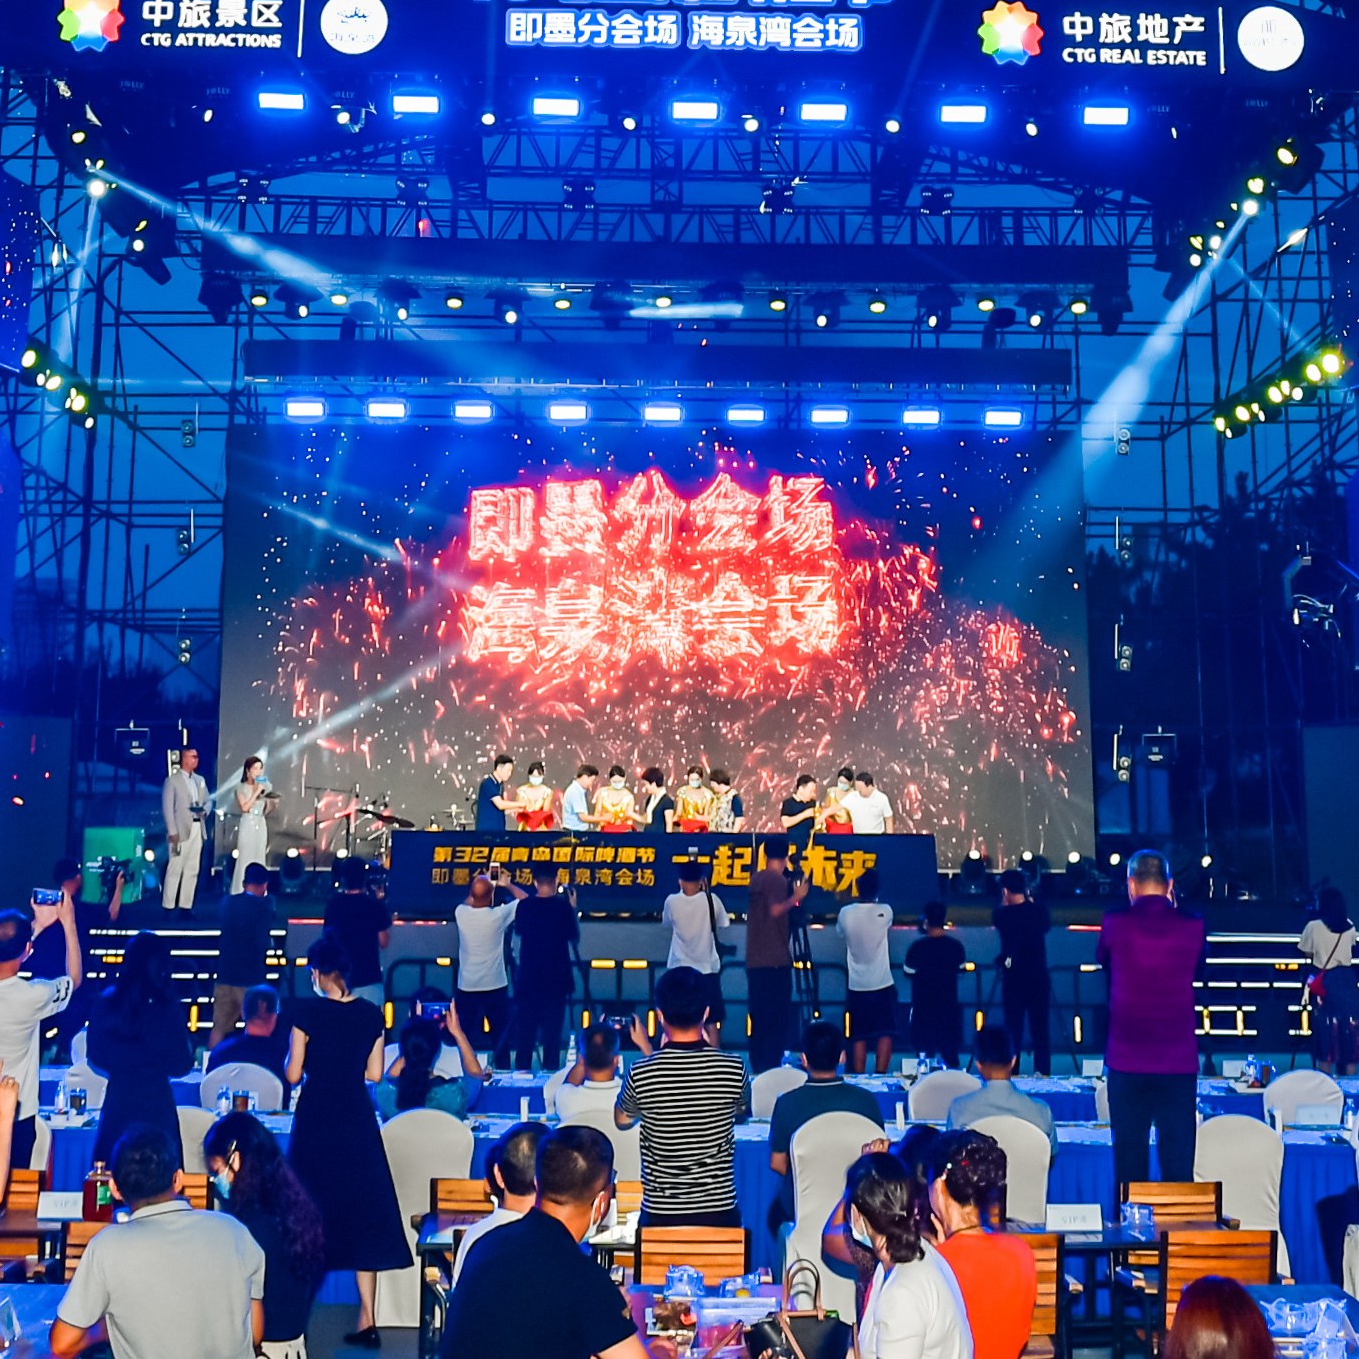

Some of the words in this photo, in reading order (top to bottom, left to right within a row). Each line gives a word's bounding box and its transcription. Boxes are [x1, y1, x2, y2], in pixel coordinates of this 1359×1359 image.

[141, 32, 172, 47] CTG
[175, 32, 281, 48] ATTRACTIONS
[510, 11, 678, 45] 即墨分会场
[692, 15, 860, 48] 海泉湾会场
[1062, 11, 1205, 44] 中旅地产
[1062, 47, 1096, 64] CTG
[1100, 48, 1142, 65] REAL
[1147, 49, 1207, 66] ESTATE
[469, 469, 834, 561] 即墨分会场
